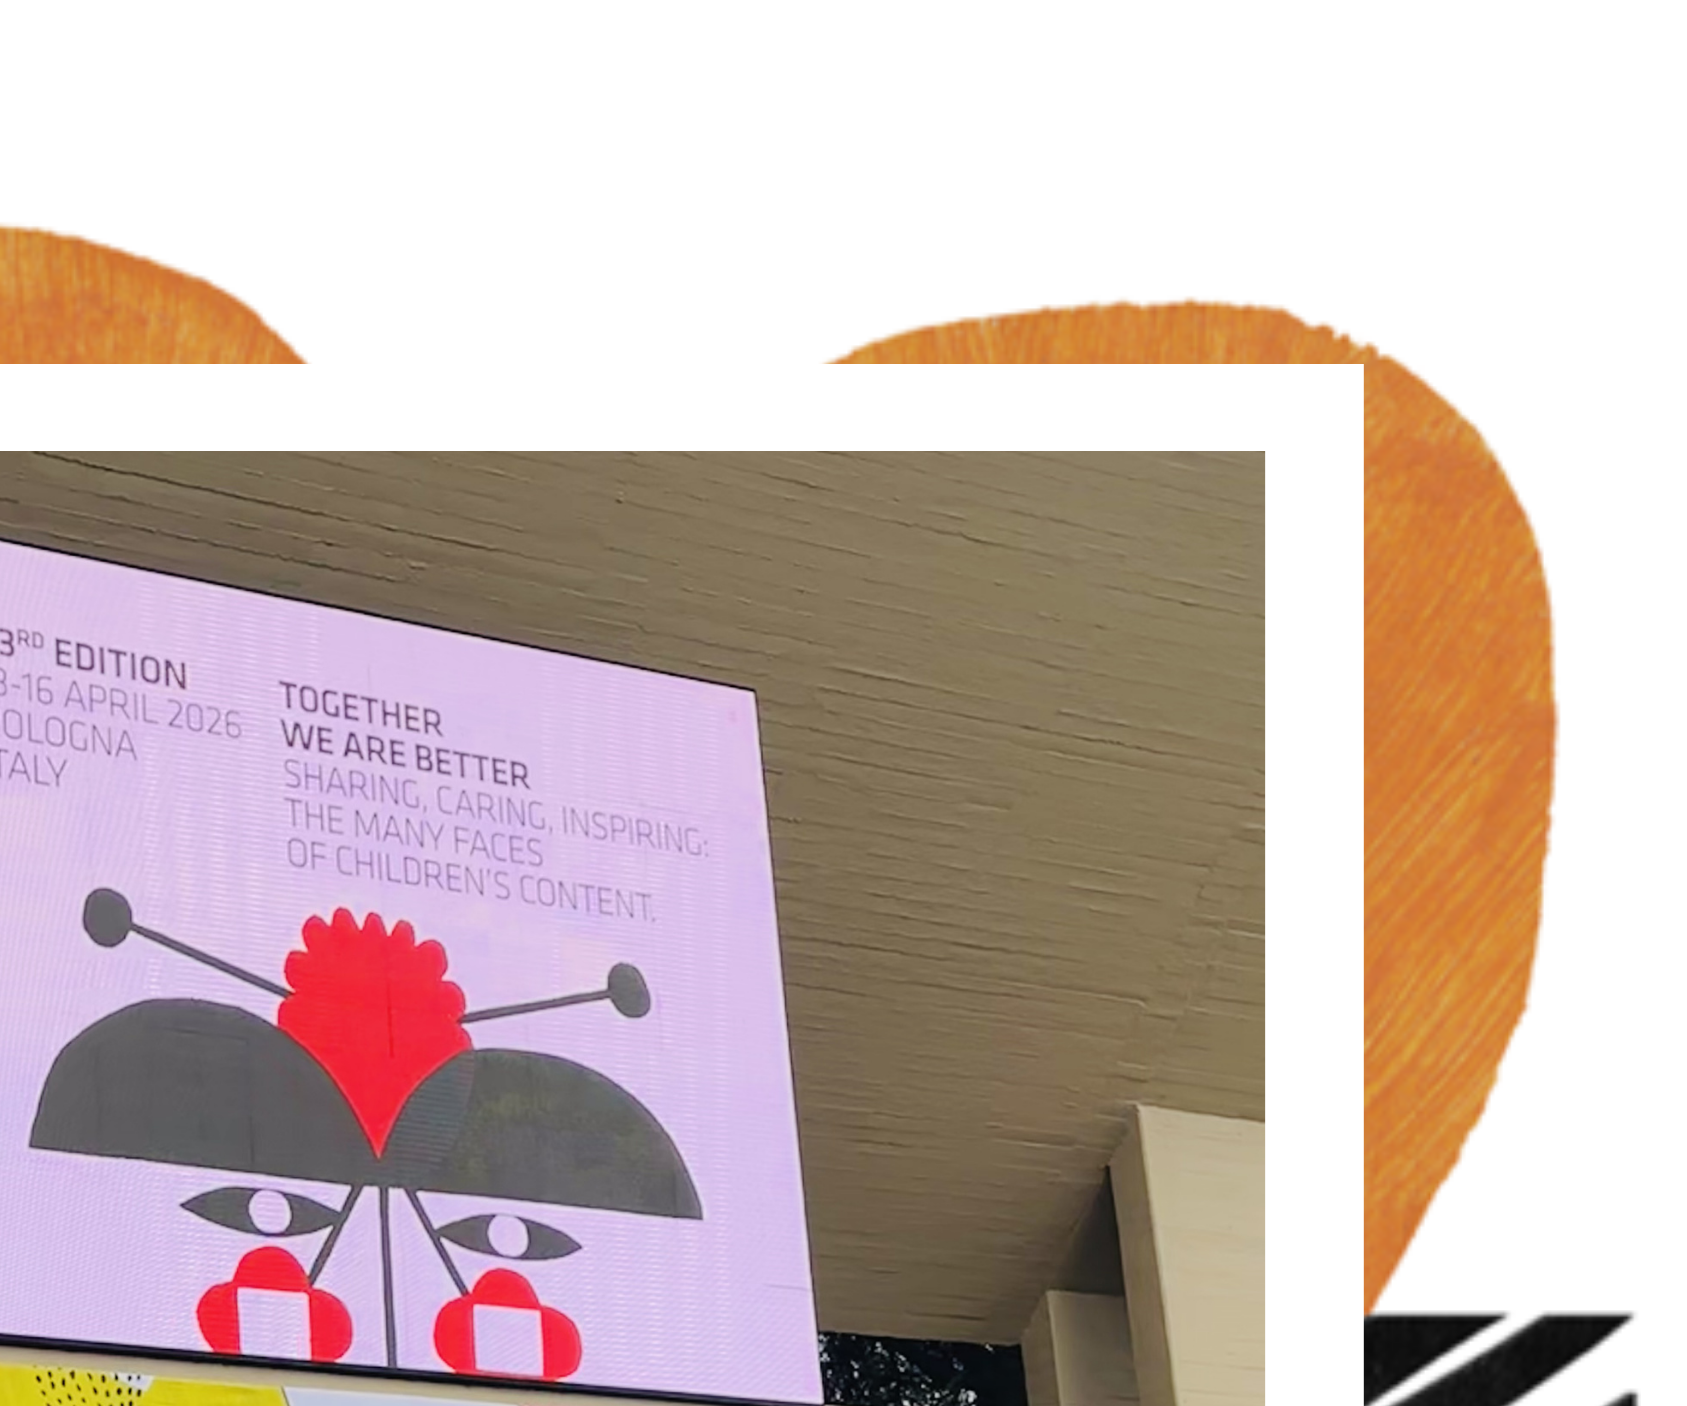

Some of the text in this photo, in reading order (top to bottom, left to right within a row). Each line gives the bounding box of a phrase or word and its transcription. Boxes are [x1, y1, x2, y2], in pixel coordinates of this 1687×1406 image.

[55, 638, 187, 690] EDITION
[64, 680, 159, 725] APRIL
[167, 699, 243, 739] 2026
[279, 680, 444, 737] TOGETHER
[280, 719, 531, 790] WE ARE BETTER
[284, 759, 710, 859] SHARING, CARING, INSPIRING:
[284, 797, 544, 867] THE MANY FACES
[287, 837, 657, 923] OF CHILDREN'S CONTENT.
